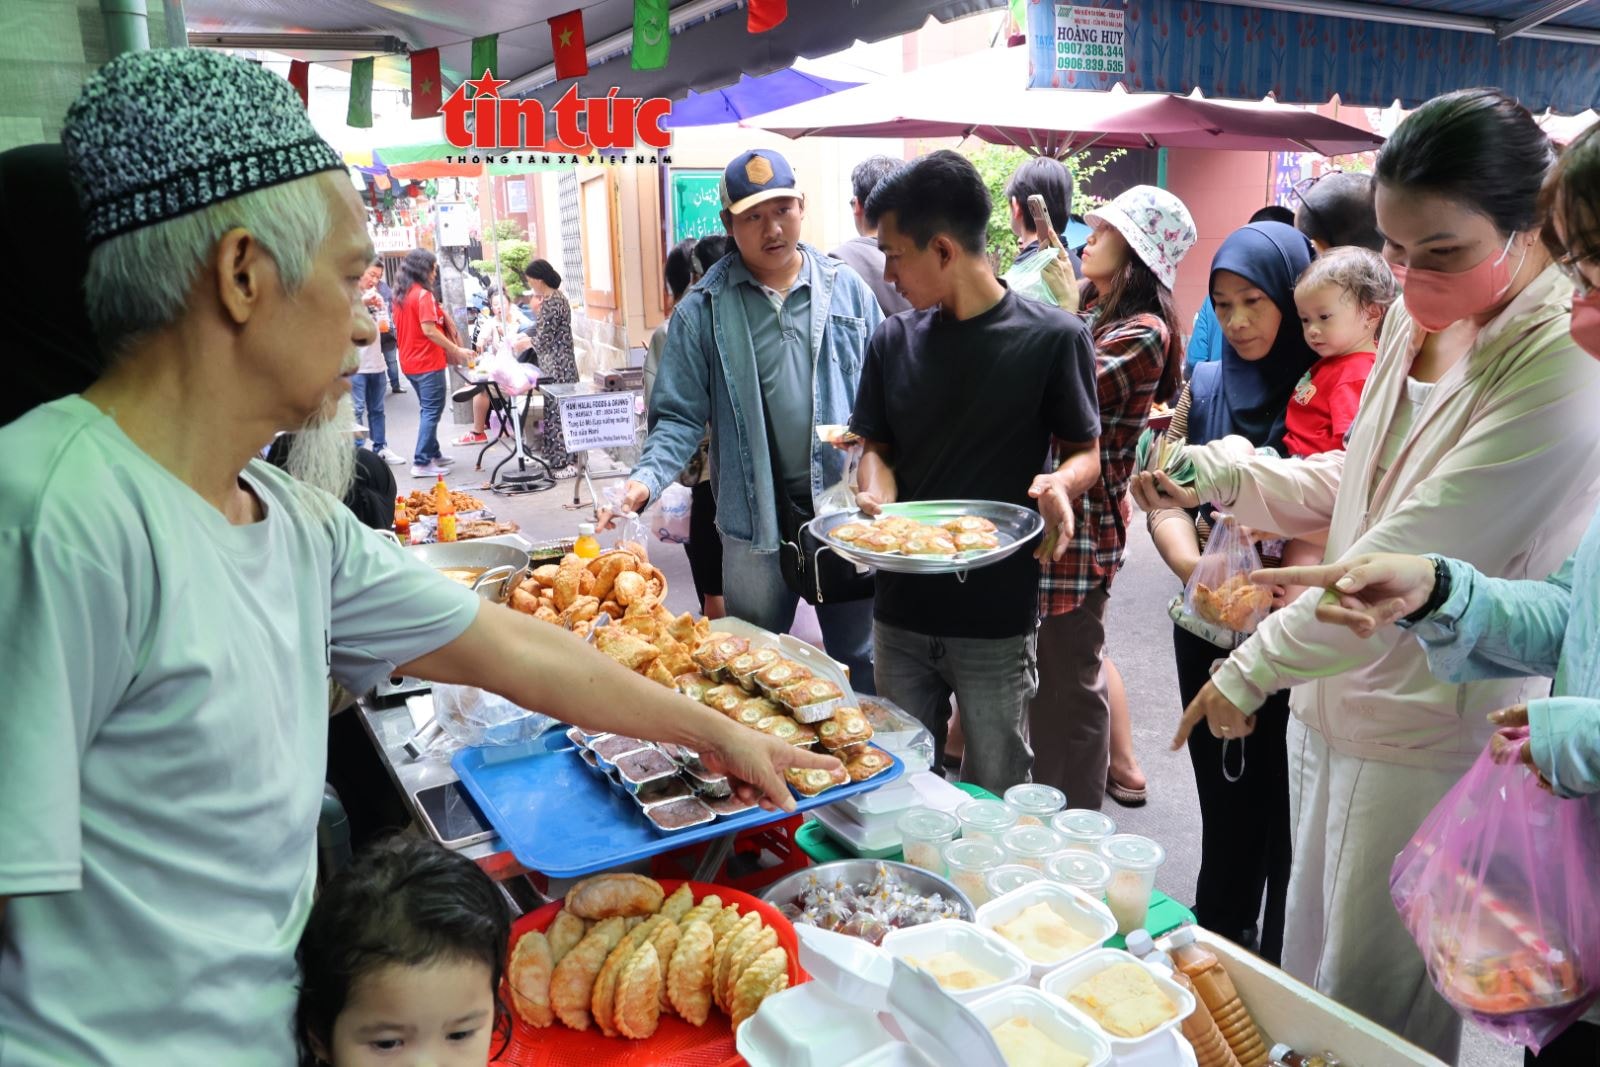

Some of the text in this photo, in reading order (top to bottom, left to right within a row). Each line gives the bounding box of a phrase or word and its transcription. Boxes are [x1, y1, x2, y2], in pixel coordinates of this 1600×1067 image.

[1057, 24, 1124, 45] HOÀNG HUY
[1057, 42, 1124, 58] 0907.388.344
[1057, 57, 1124, 73] 0906.839.535
[578, 401, 592, 409] HALAL
[592, 400, 607, 408] FOODS
